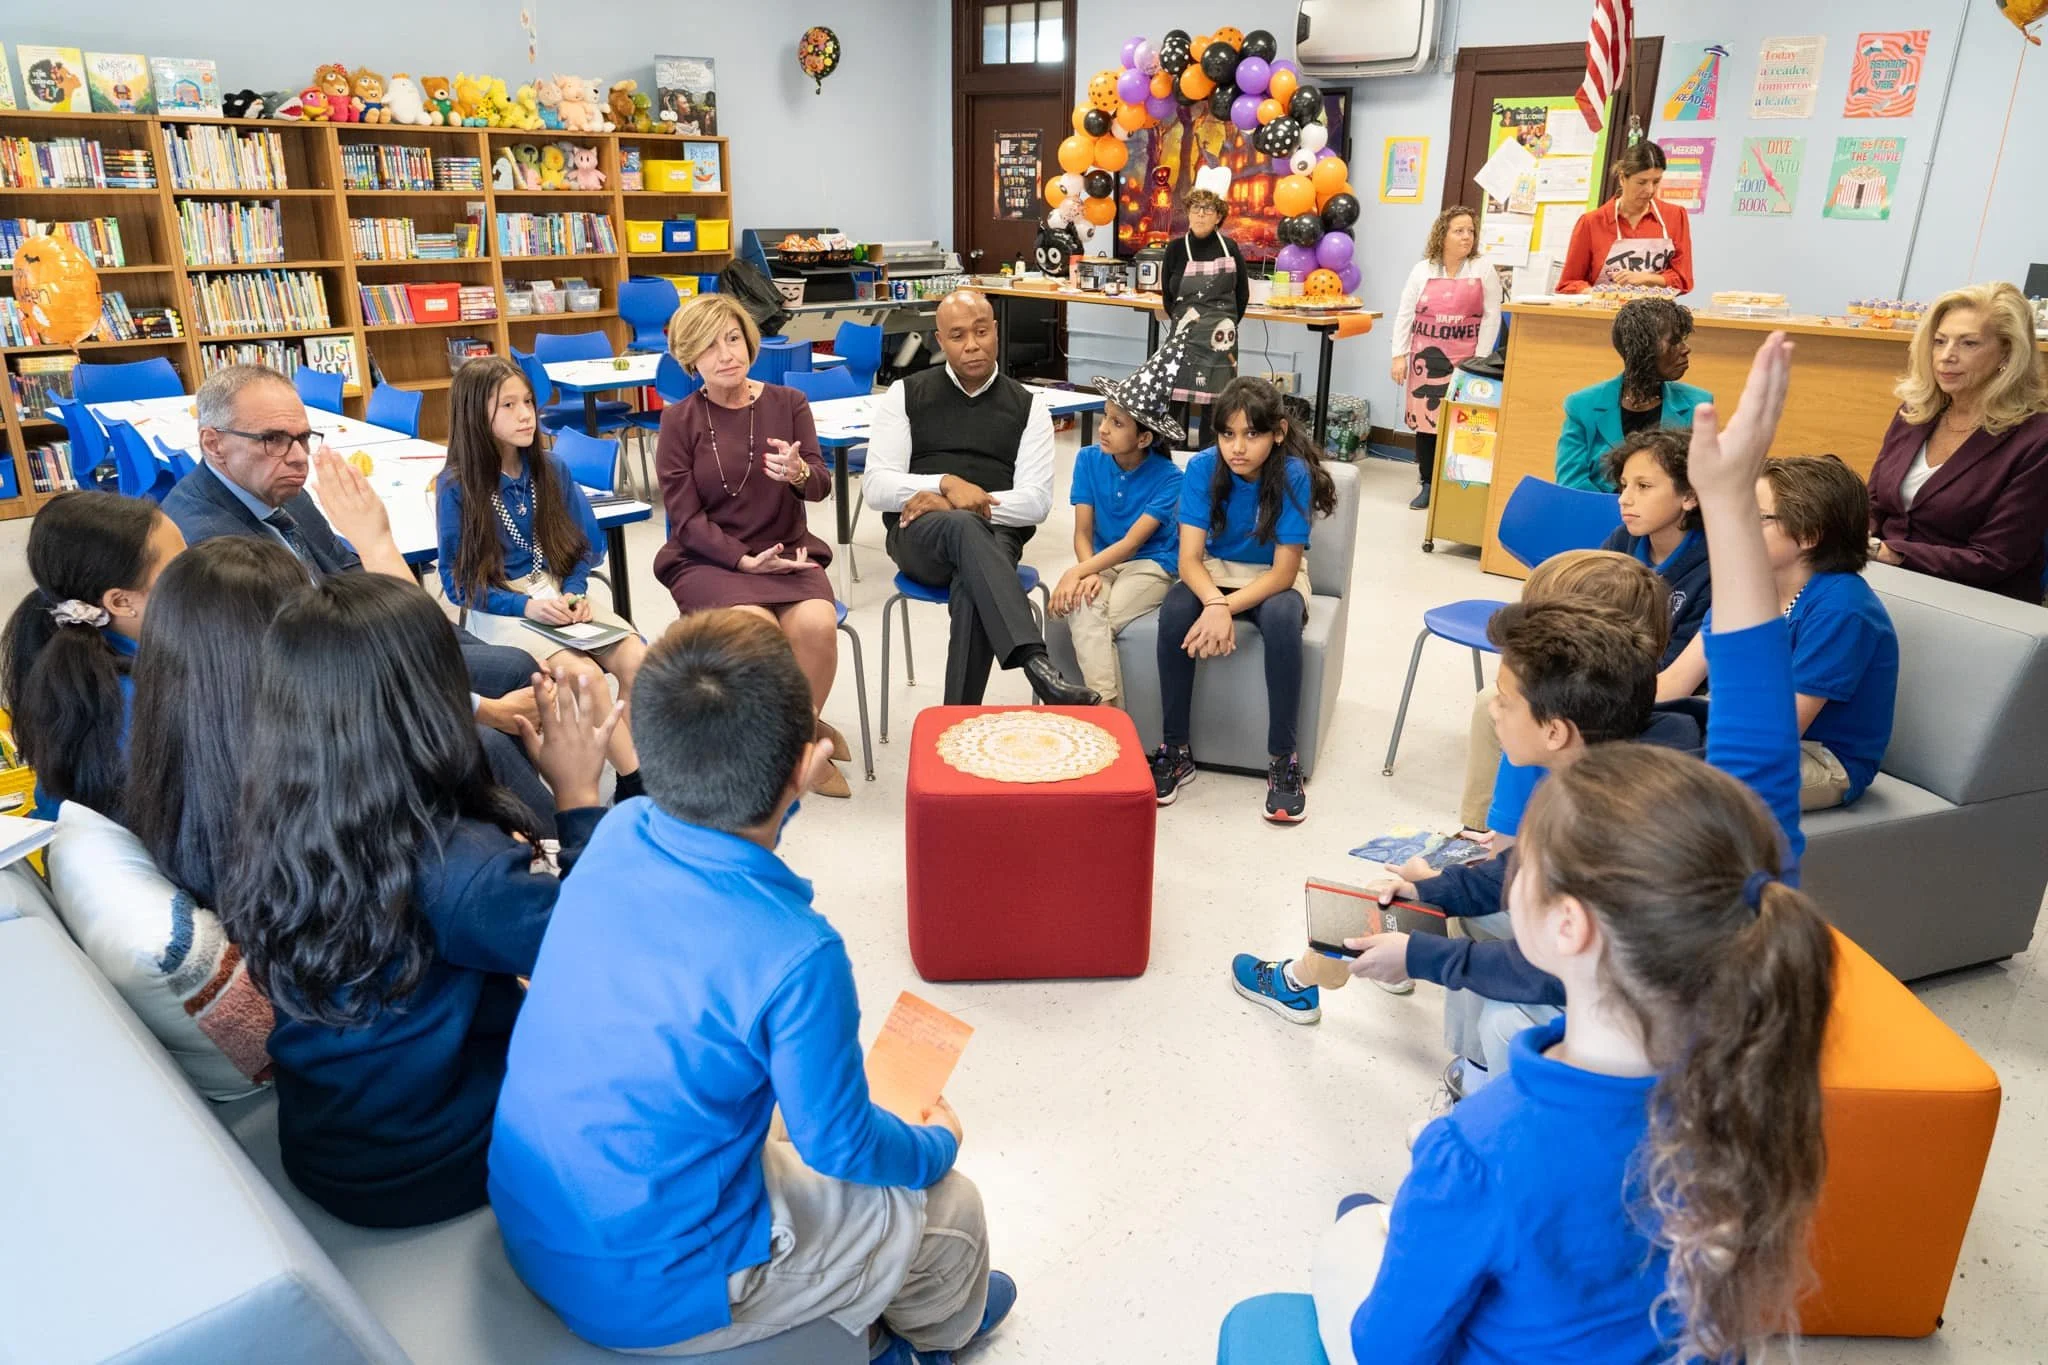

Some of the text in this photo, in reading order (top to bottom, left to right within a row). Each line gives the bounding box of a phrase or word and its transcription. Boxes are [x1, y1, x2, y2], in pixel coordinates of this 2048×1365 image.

[1870, 58, 1908, 69] READING
[1759, 68, 1768, 76] a
[1873, 80, 1896, 90] VIBE
[1754, 98, 1761, 106] a
[1670, 144, 1705, 155] WEEKEND
[1767, 140, 1793, 155] DIVE
[1861, 139, 1898, 149] BETTER
[1851, 151, 1869, 161] THE
[1872, 151, 1902, 161] MOVIE
[1775, 160, 1801, 174] INTO
[1737, 198, 1768, 212] BOOK
[1605, 248, 1676, 273] TRICK
[1436, 313, 1466, 324] HAPPY
[1411, 320, 1481, 340] HALLOWEE
[313, 339, 351, 363] JUST
